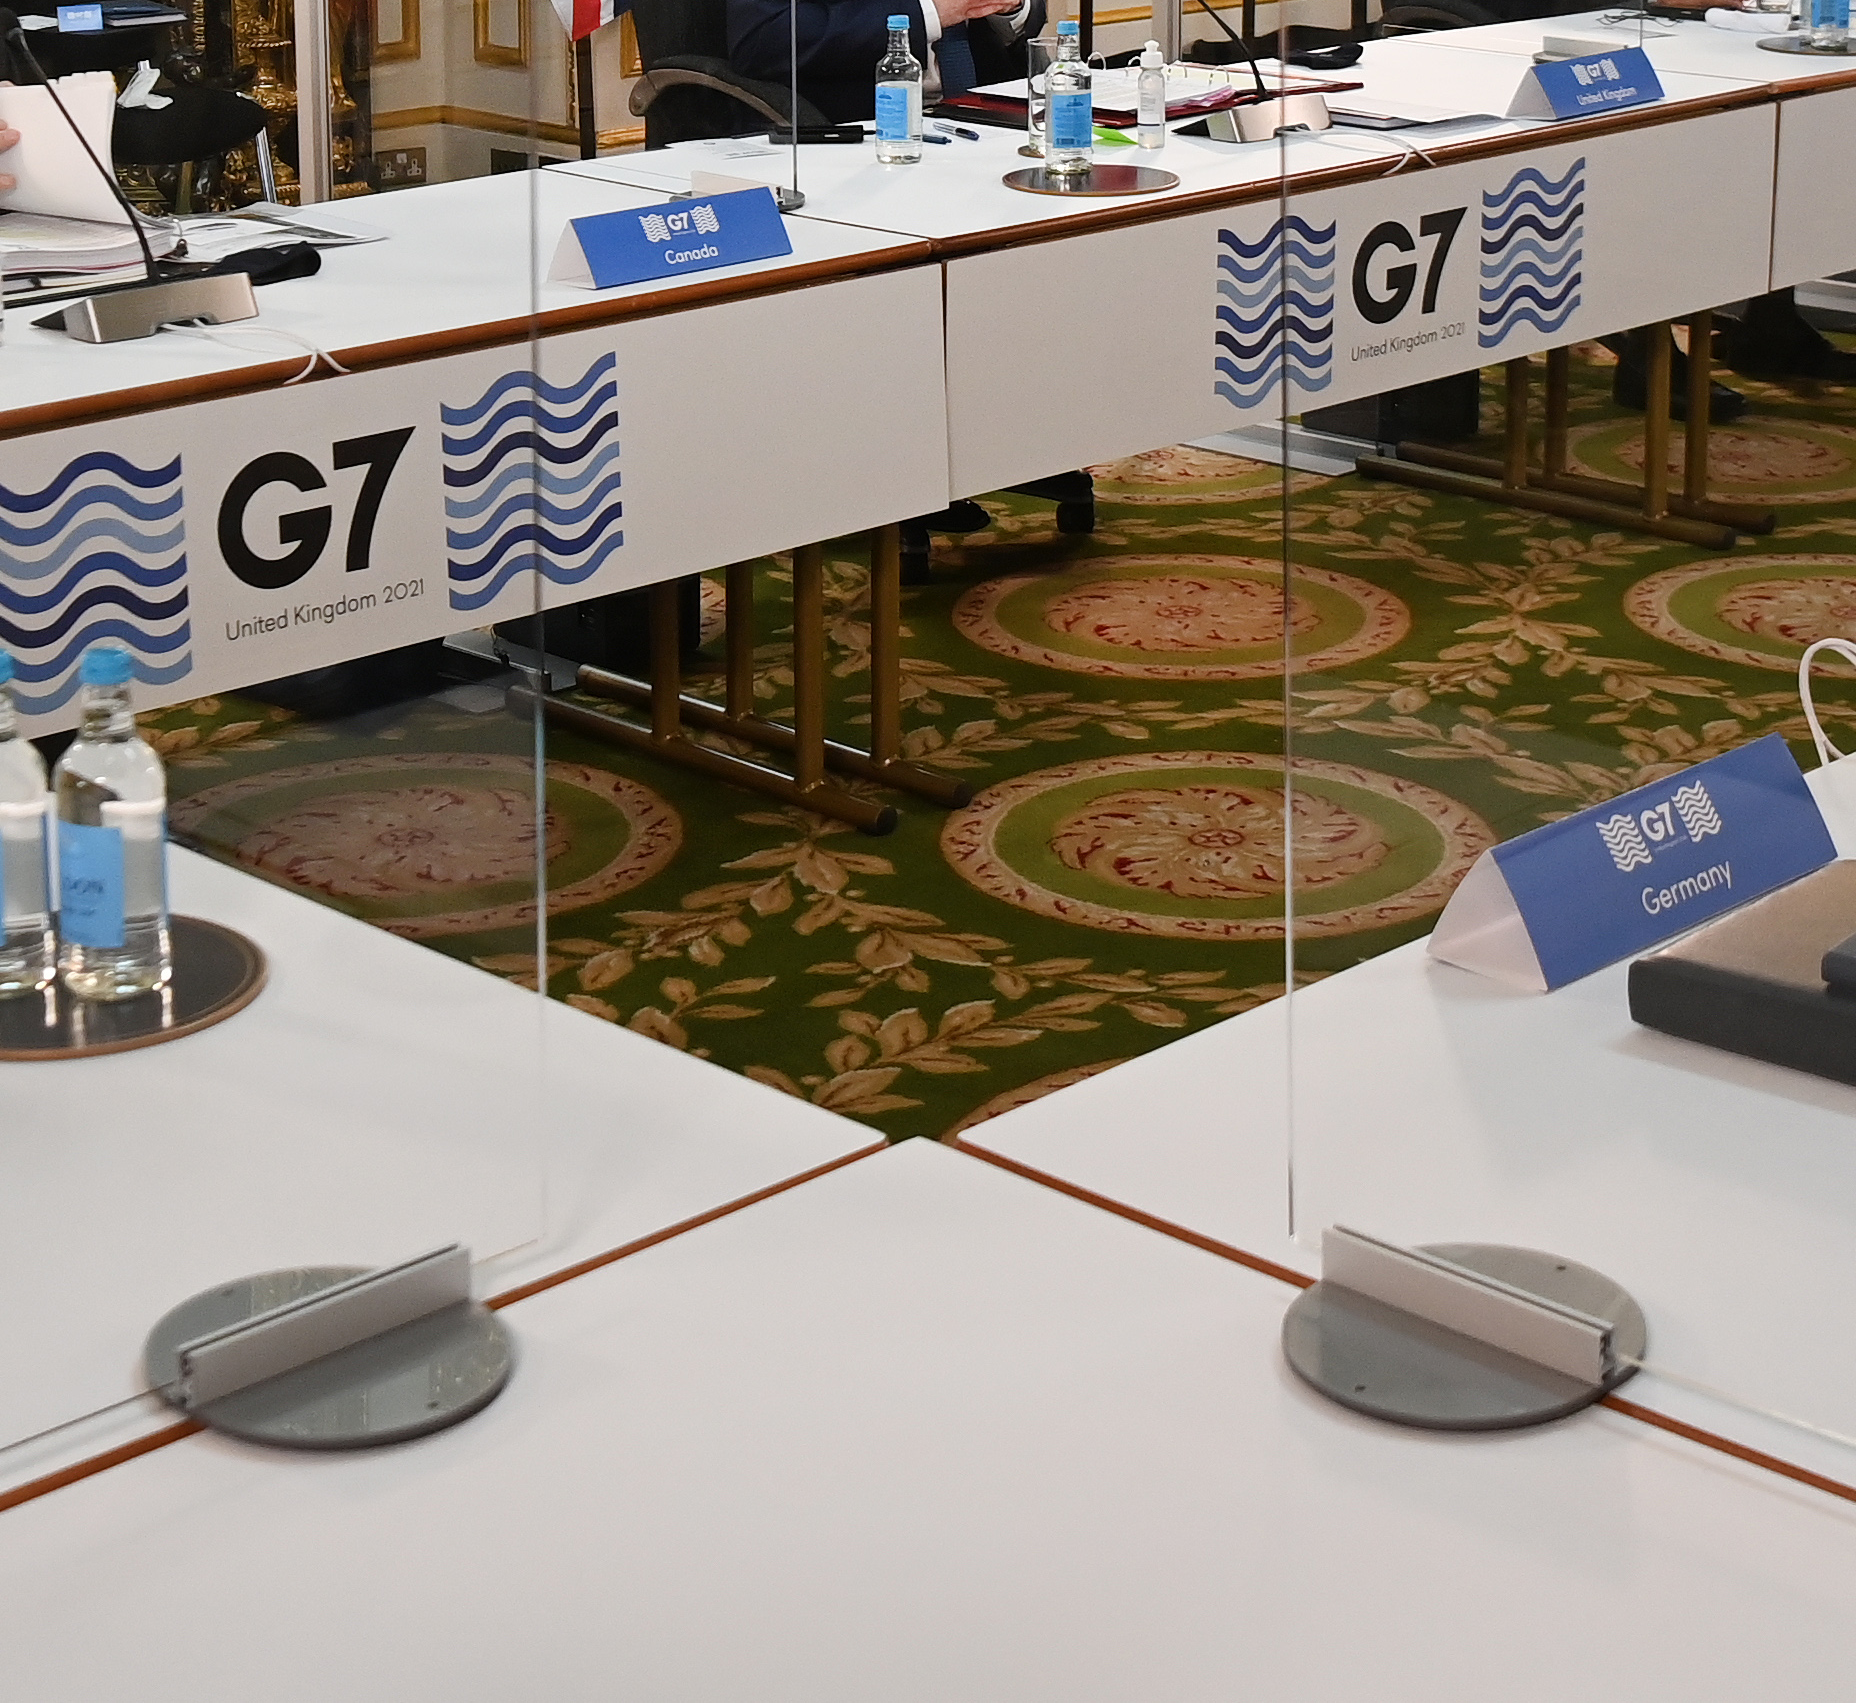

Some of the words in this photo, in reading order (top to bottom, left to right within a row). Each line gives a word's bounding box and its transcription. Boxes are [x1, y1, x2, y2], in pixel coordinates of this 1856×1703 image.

[1586, 63, 1602, 78] G7
[666, 211, 689, 231] G7
[664, 243, 719, 265] Canada
[1352, 206, 1469, 324] G7
[1350, 338, 1388, 362] United
[1389, 330, 1437, 353] Kingdom
[1440, 321, 1466, 340] 2021
[217, 425, 417, 590] G7
[225, 607, 289, 641] United
[293, 594, 377, 624] Kingdom
[382, 578, 425, 605] 2021
[1640, 801, 1675, 841] G7
[1641, 860, 1732, 915] Germany
